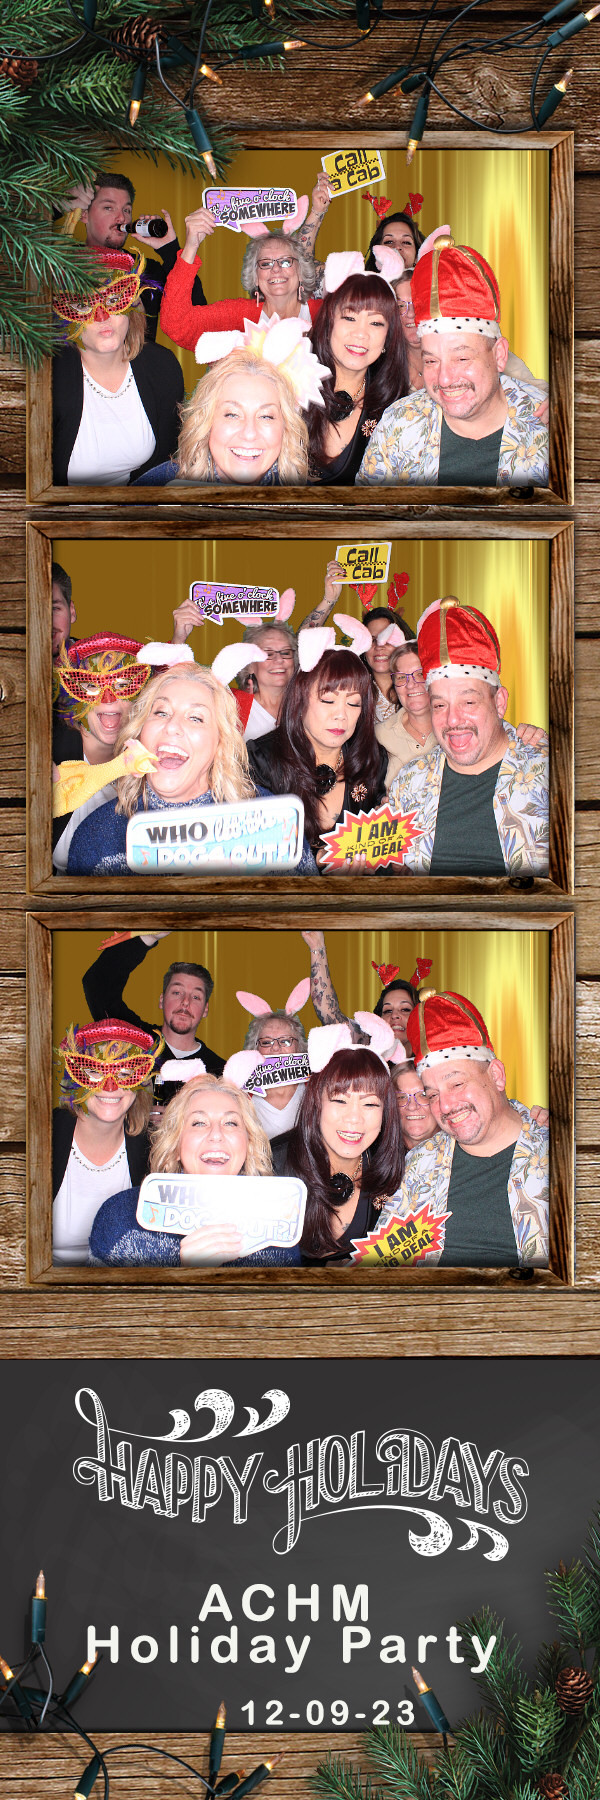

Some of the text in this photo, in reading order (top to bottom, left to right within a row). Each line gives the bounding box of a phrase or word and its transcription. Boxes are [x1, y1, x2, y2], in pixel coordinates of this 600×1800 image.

[330, 178, 342, 191] a
[230, 195, 252, 212] five
[220, 202, 296, 225] SOMEWHERE
[215, 591, 237, 605] five
[204, 599, 278, 616] SOMEWHERE
[146, 821, 208, 844] WHO
[356, 819, 399, 842] I AM
[347, 841, 376, 851] KIND
[378, 835, 395, 845] OF
[372, 840, 403, 858] DEAL
[373, 1220, 418, 1258] I AM
[401, 1233, 435, 1261] DEAL
[403, 1234, 418, 1248] OF
